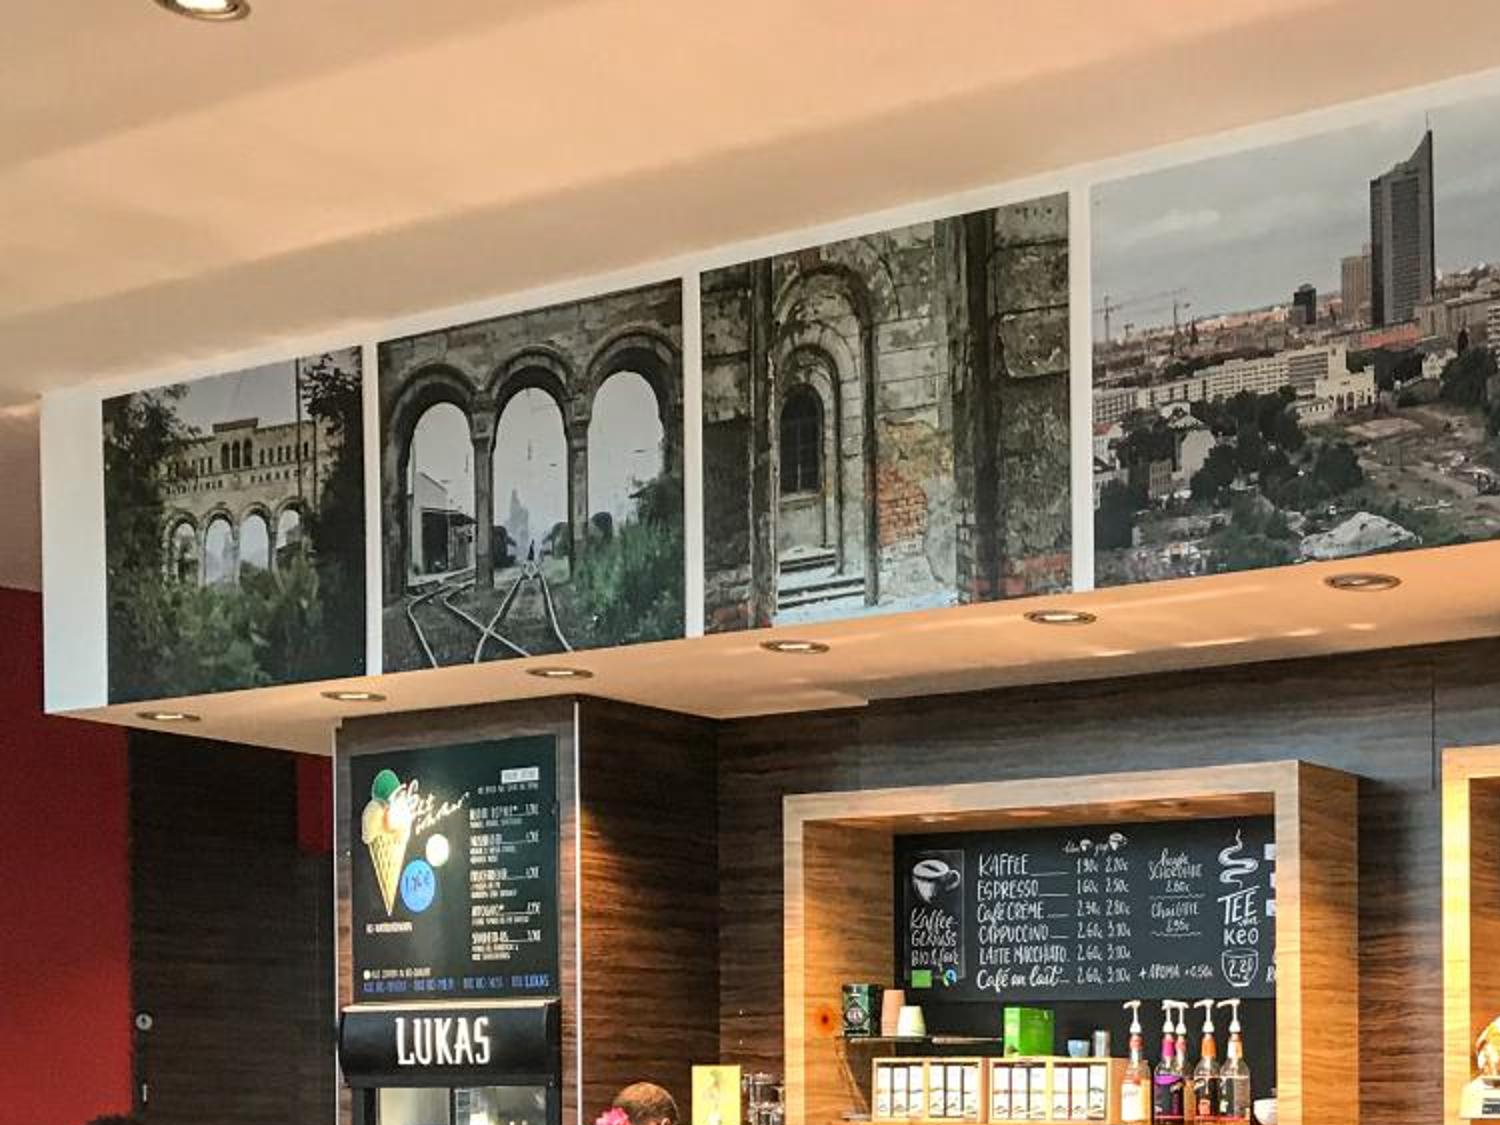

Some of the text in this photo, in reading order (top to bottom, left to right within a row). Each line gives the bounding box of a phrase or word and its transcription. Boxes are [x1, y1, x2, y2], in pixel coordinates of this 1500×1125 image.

[979, 853, 1029, 877] KAFFEE
[977, 880, 1039, 902] ESPRESSO
[1218, 886, 1260, 925] TEE
[979, 924, 1049, 945] CAPPUCCINO
[980, 947, 1011, 965] LATTE
[976, 967, 1009, 992] Café
[395, 1016, 491, 1066] LUKAS
